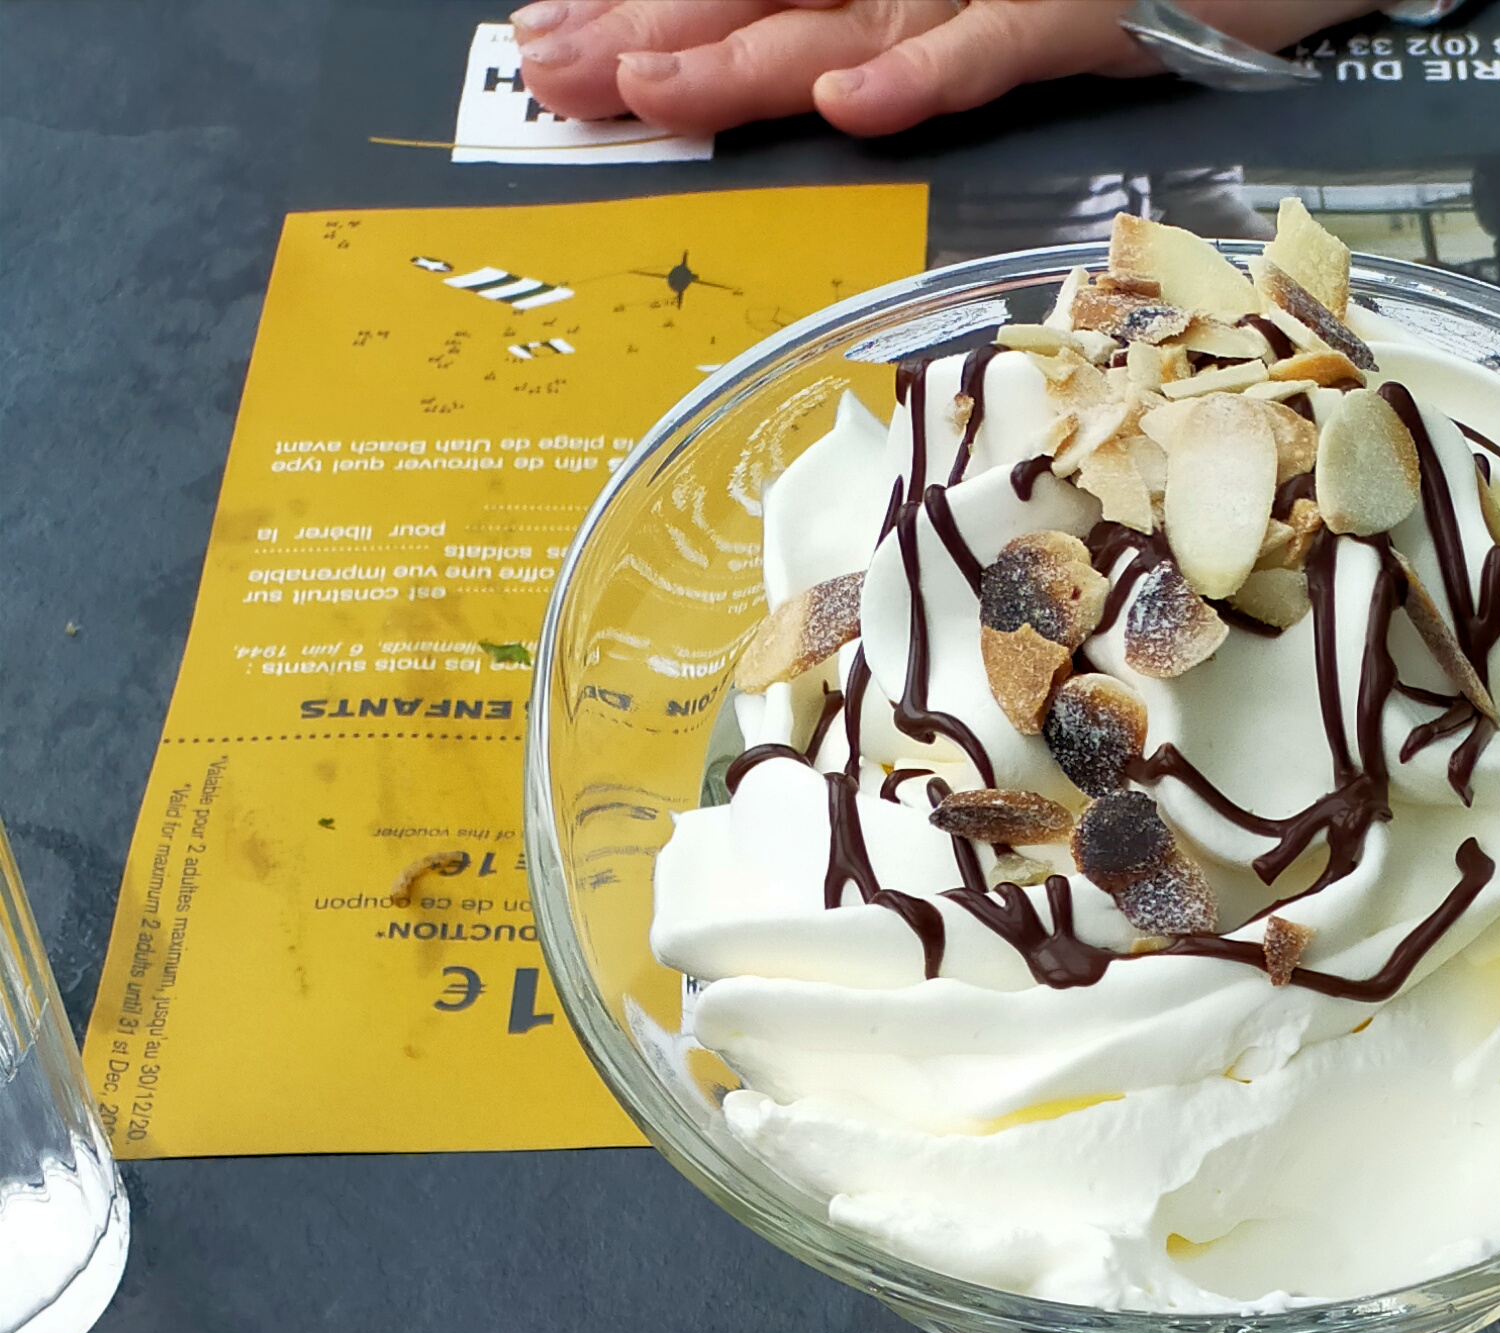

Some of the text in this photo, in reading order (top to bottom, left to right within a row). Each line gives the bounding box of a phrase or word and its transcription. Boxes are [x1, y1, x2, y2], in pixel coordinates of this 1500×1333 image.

[1336, 59, 1404, 82] DU
[274, 440, 342, 455] avant
[350, 439, 427, 455] Beach
[434, 438, 492, 453] Utah
[500, 437, 531, 452] de
[537, 434, 605, 453] plage
[271, 456, 323, 473] type
[332, 456, 385, 473] quel
[394, 457, 504, 472] retrouver
[513, 456, 545, 473] de
[554, 456, 599, 474] afin
[256, 521, 446, 543] pour libérer la
[443, 545, 532, 561] soldats
[247, 563, 555, 585] offre une vue imprenable
[242, 585, 447, 604] est construit sur
[262, 660, 367, 677] suivants
[375, 658, 437, 673] mots
[445, 659, 481, 674] les
[298, 698, 512, 720] ENFANTS
[161, 820, 182, 841] for
[191, 808, 210, 839] pour
[371, 827, 450, 841] voucher
[187, 844, 206, 854] 2
[144, 843, 170, 915] maximum
[176, 857, 200, 913] adultes
[420, 897, 453, 911] ce
[461, 899, 494, 916] de
[141, 918, 161, 930] 2
[130, 932, 157, 979] adults
[122, 982, 144, 1016] until
[117, 1017, 140, 1036] 31
